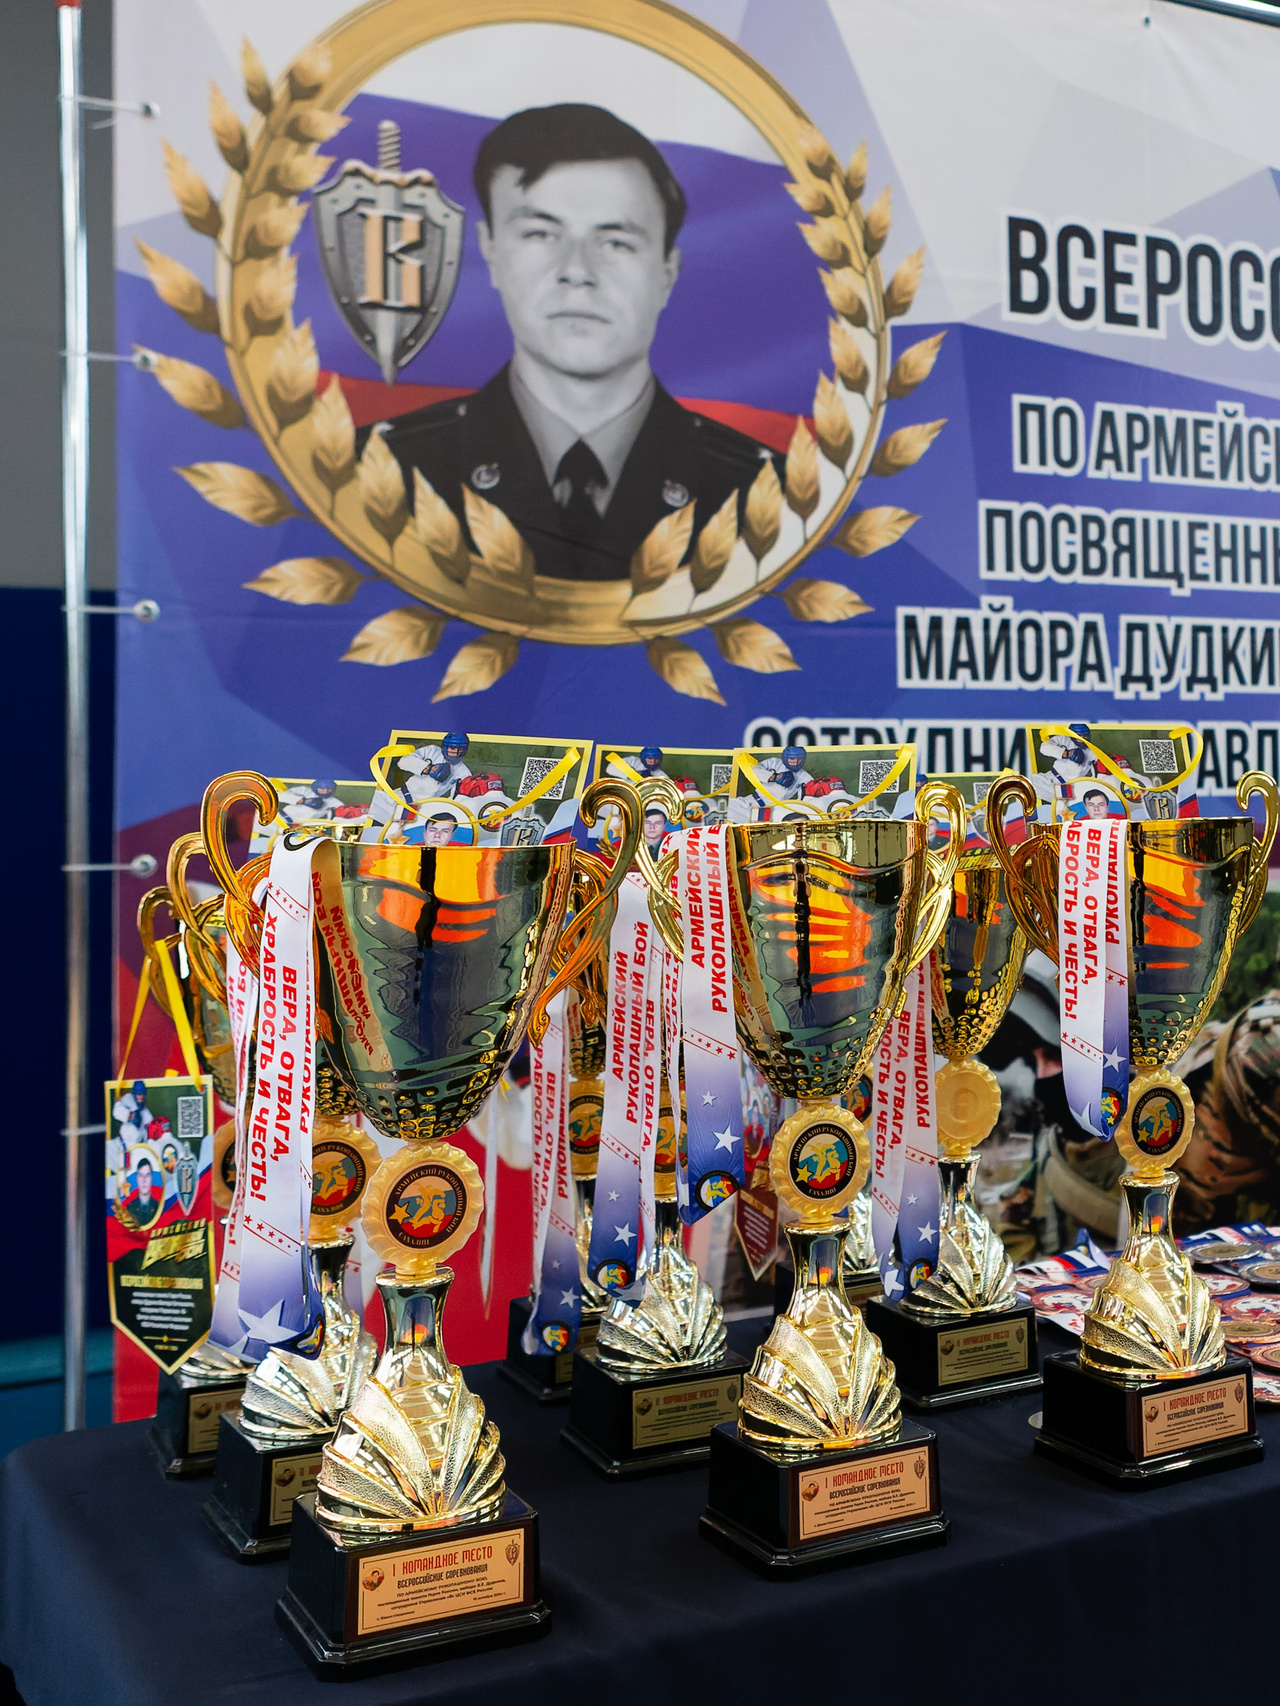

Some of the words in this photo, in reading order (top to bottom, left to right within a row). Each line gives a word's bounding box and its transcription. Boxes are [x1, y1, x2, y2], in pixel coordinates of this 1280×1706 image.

[1019, 403, 1078, 468] ПО
[904, 604, 1106, 683] МАЙОРА
[1064, 820, 1083, 913] АБРОСТЬ
[1082, 828, 1102, 888] ВЕРА,
[684, 827, 705, 969] АРМЕЙСКИЙ
[703, 843, 728, 1013] РУКОПАШНЫЙ
[1064, 921, 1077, 936] И
[633, 921, 649, 963] БОЙ
[1082, 895, 1098, 985] ОТВАГА,
[257, 911, 278, 1069] ХРАБРОСТЬ
[279, 965, 297, 1041] ВЕРА,
[611, 950, 629, 1082] АРМЕЙСКИЙ
[1064, 942, 1078, 1020] ЧЕСТЬ!
[626, 968, 645, 1124] РУКОПАШНЫЙ
[893, 1010, 911, 1062] ВЕРА,
[257, 1077, 271, 1097] И
[270, 1055, 295, 1162] ОТВАГА,
[877, 1092, 889, 1105] И
[888, 1071, 907, 1151] ОТВАГА,
[250, 1107, 270, 1202] ЧЕСТЬ!
[832, 1467, 877, 1487] КОМАНДНОЕ
[879, 1461, 904, 1478] МЕСТО
[402, 1551, 459, 1575] КОМАНДНОЕ
[462, 1545, 493, 1564] МЕСТО
